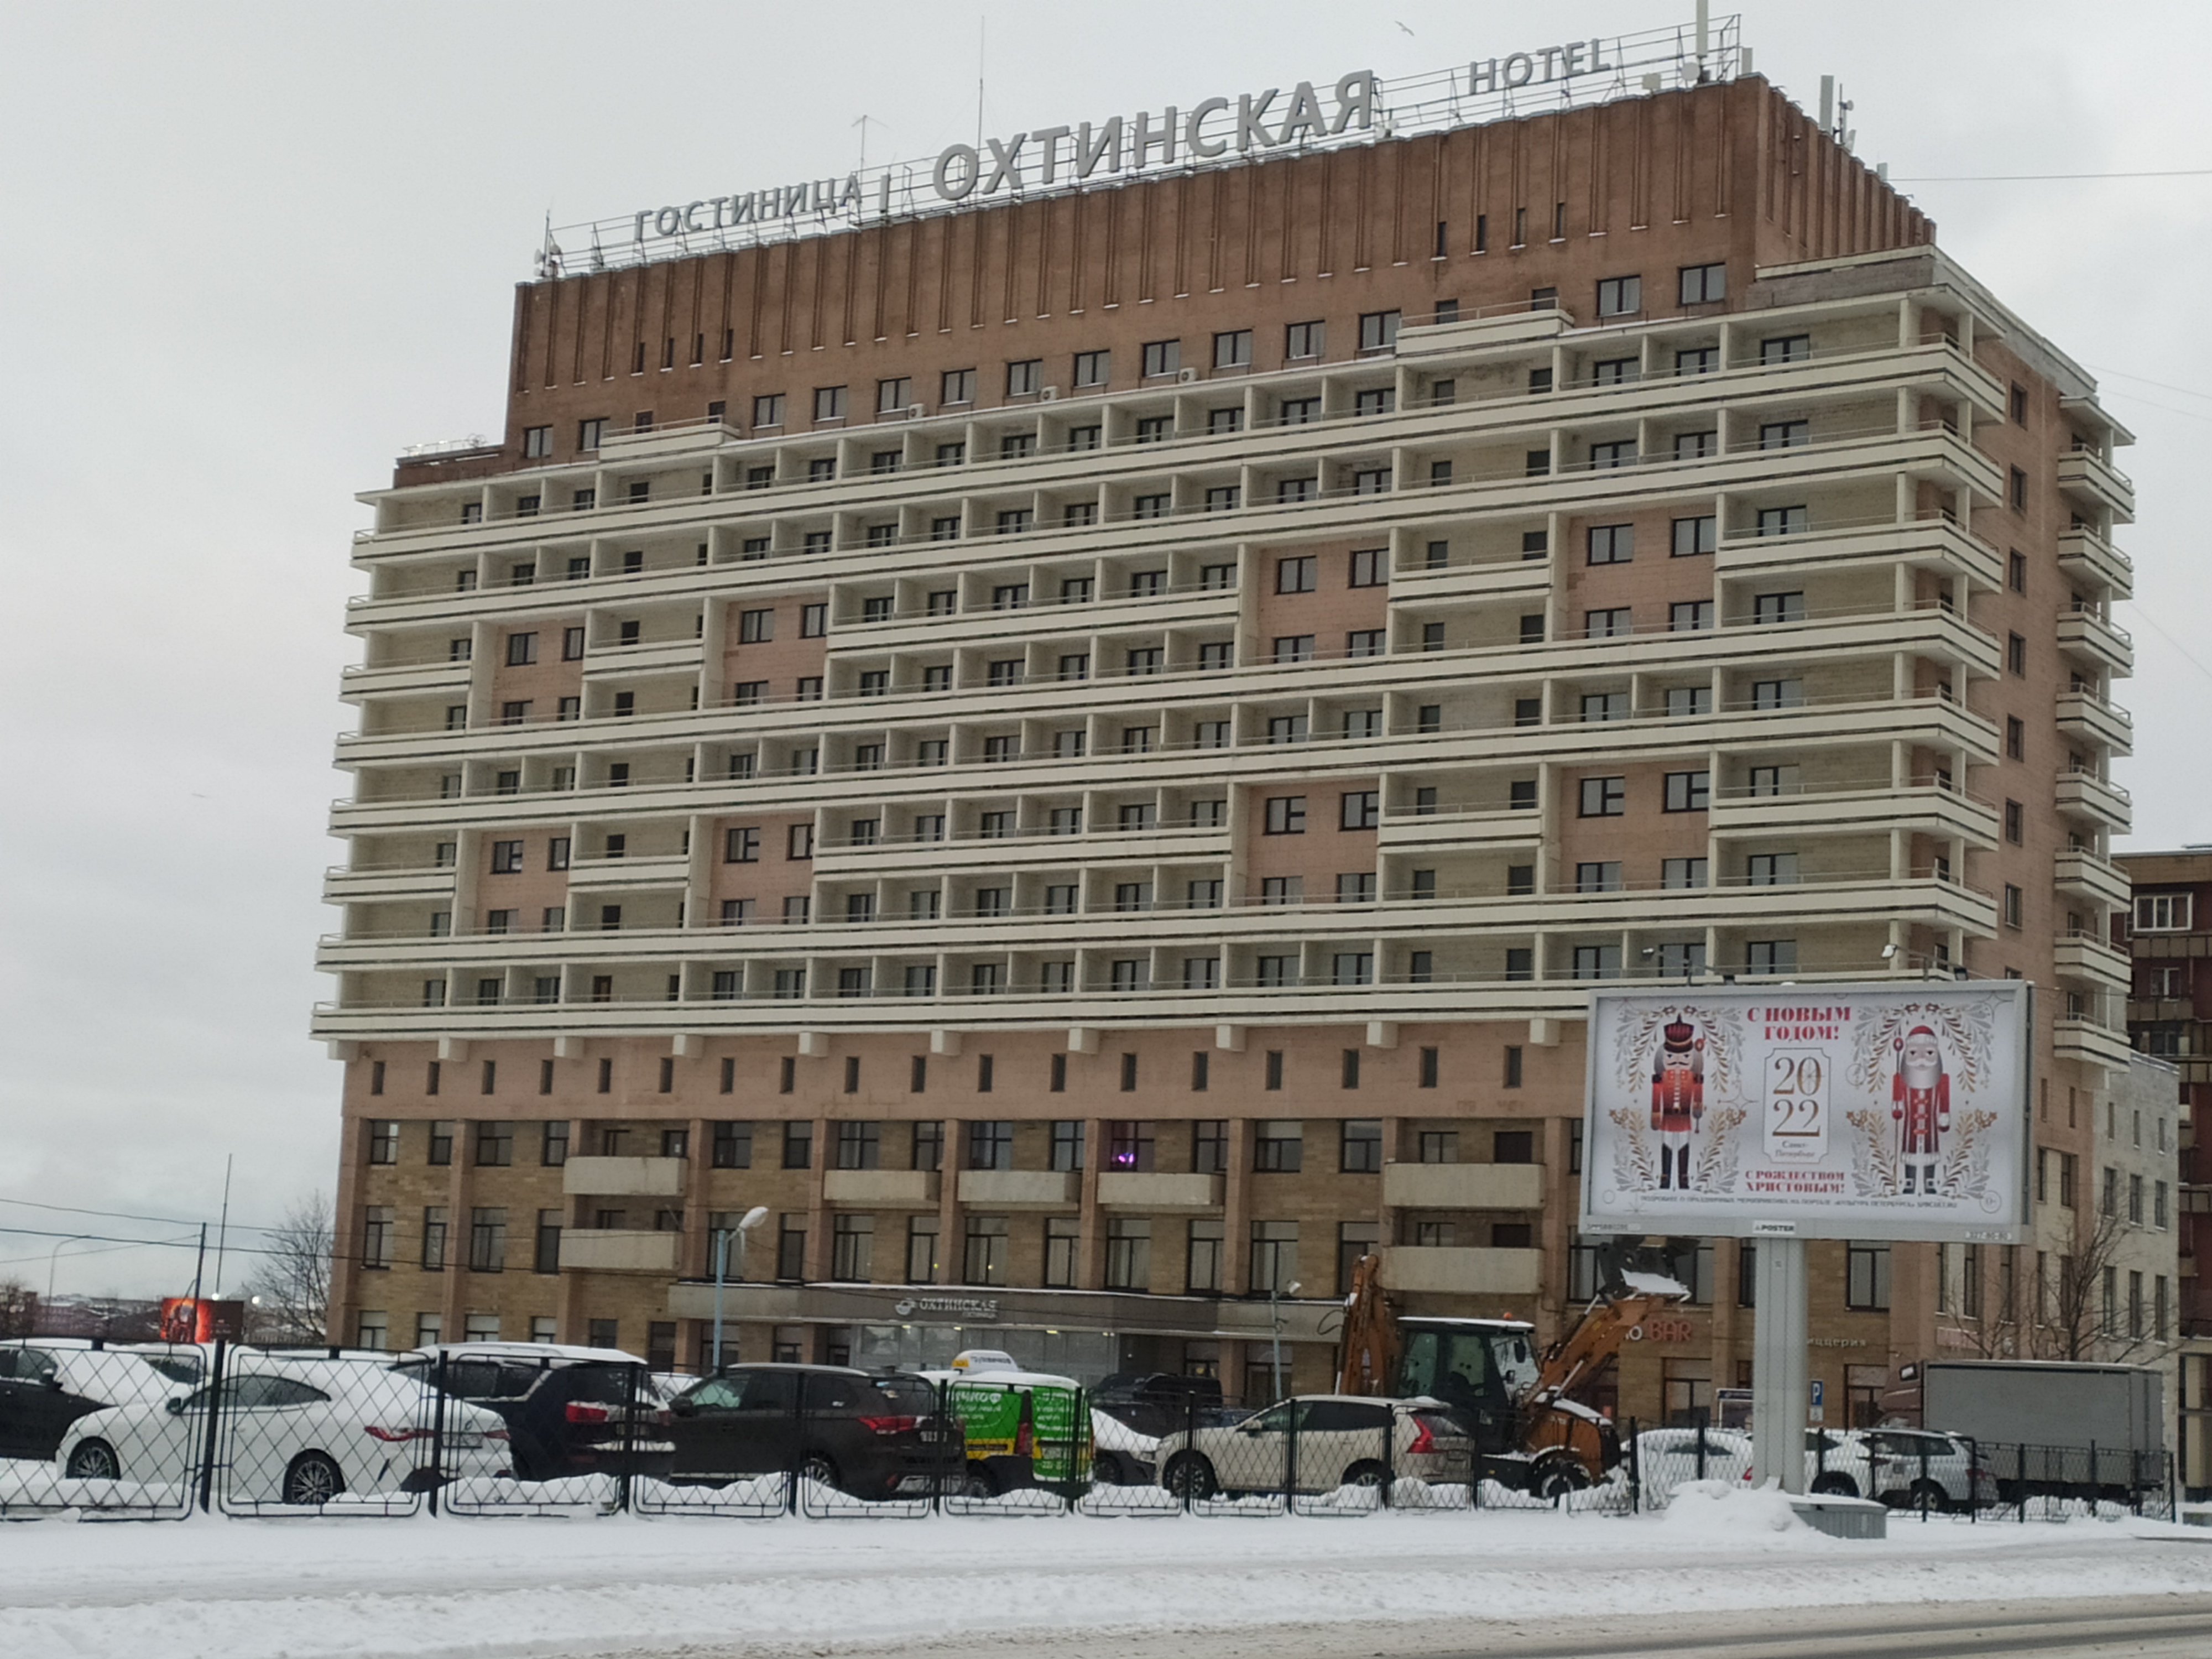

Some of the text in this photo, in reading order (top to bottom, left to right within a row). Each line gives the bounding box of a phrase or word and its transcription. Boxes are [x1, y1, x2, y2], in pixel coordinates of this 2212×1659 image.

[1468, 38, 1611, 95] HOTEL
[633, 69, 1374, 242] ГОСТИНИЦА ОХТИНСКАЯ
[1747, 1006, 1851, 1022] С НОВЫМ
[1764, 1025, 1839, 1043] ГОДОМ!
[1773, 1056, 1822, 1097] 20
[1772, 1098, 1821, 1138] 22
[1755, 1170, 1845, 1181] РОЖДЕСТВОМ
[1761, 1224, 1794, 1232] POSTER
[1648, 1319, 1693, 1341] BAR
[1813, 1383, 1820, 1403] P
